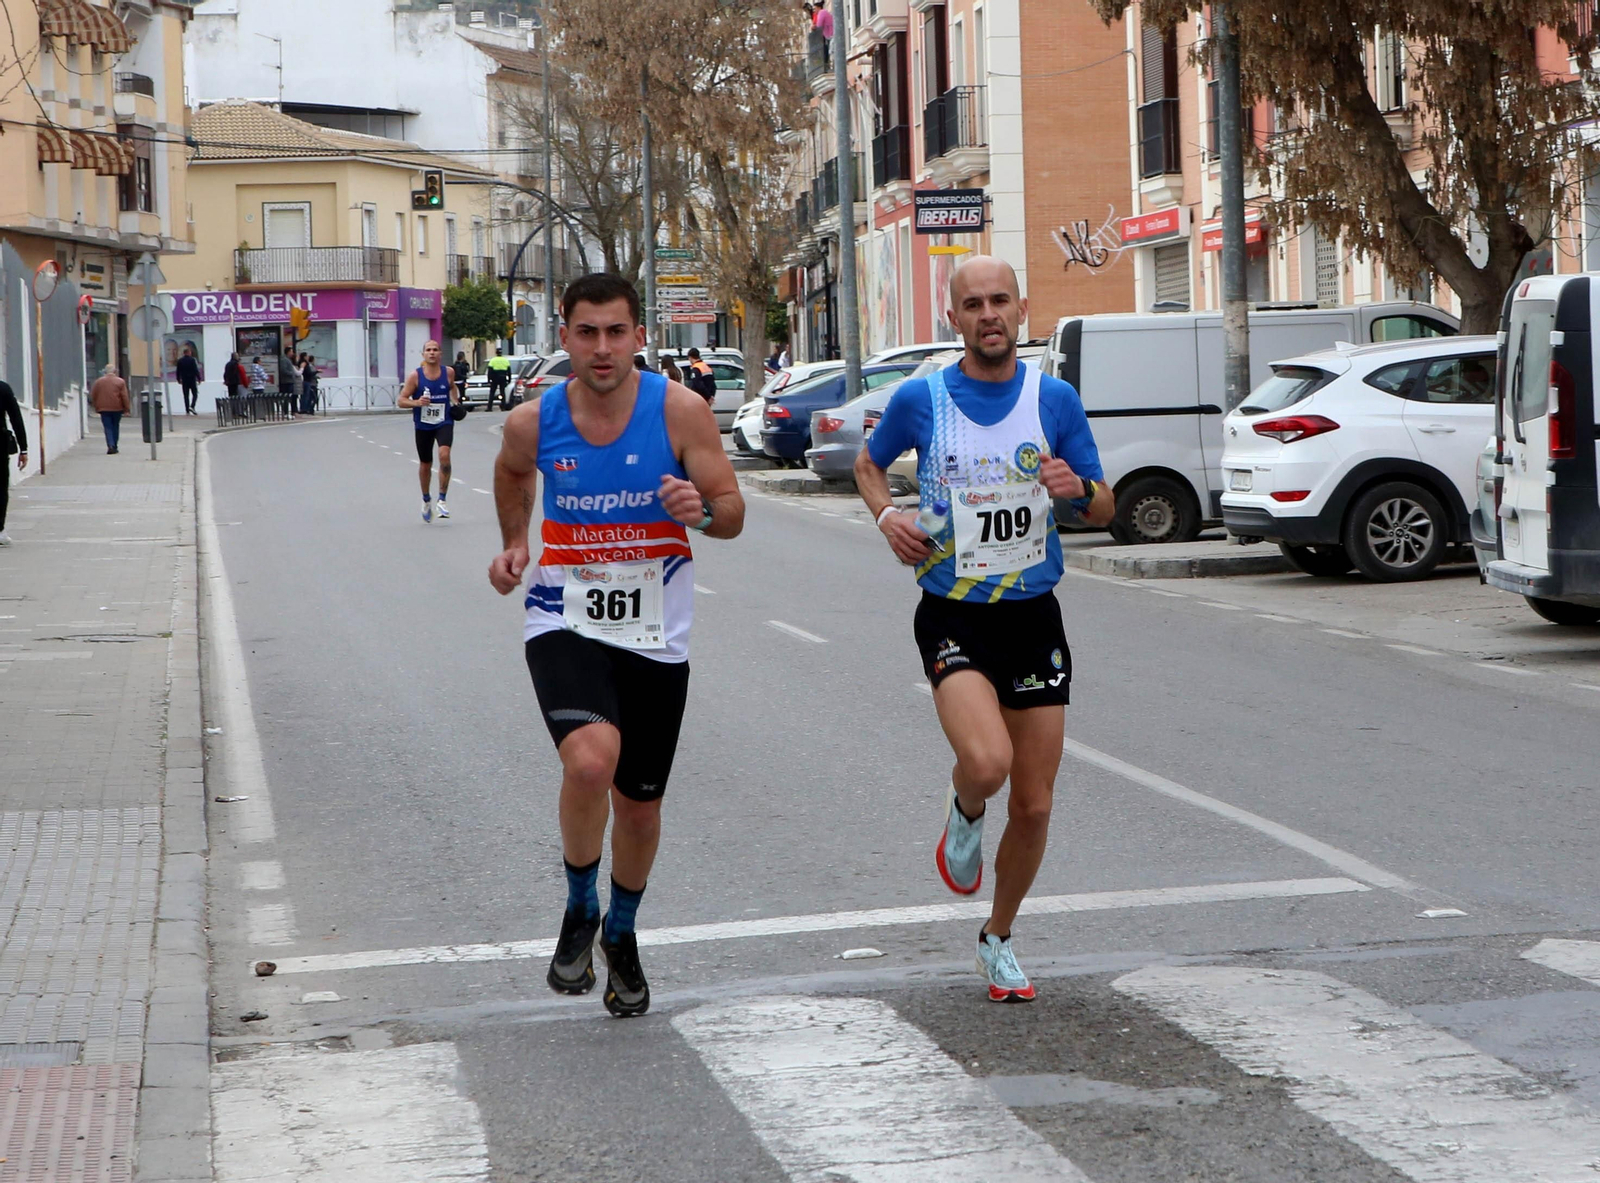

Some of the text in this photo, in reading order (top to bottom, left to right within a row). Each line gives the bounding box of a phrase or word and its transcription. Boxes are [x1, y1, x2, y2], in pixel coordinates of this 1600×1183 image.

[916, 195, 982, 205] SUPERMERCADOS
[182, 292, 317, 314] ORALDENT
[556, 490, 654, 513] enerplus
[572, 525, 647, 542] Maratón
[976, 506, 1032, 543] 709
[586, 588, 641, 621] 361
